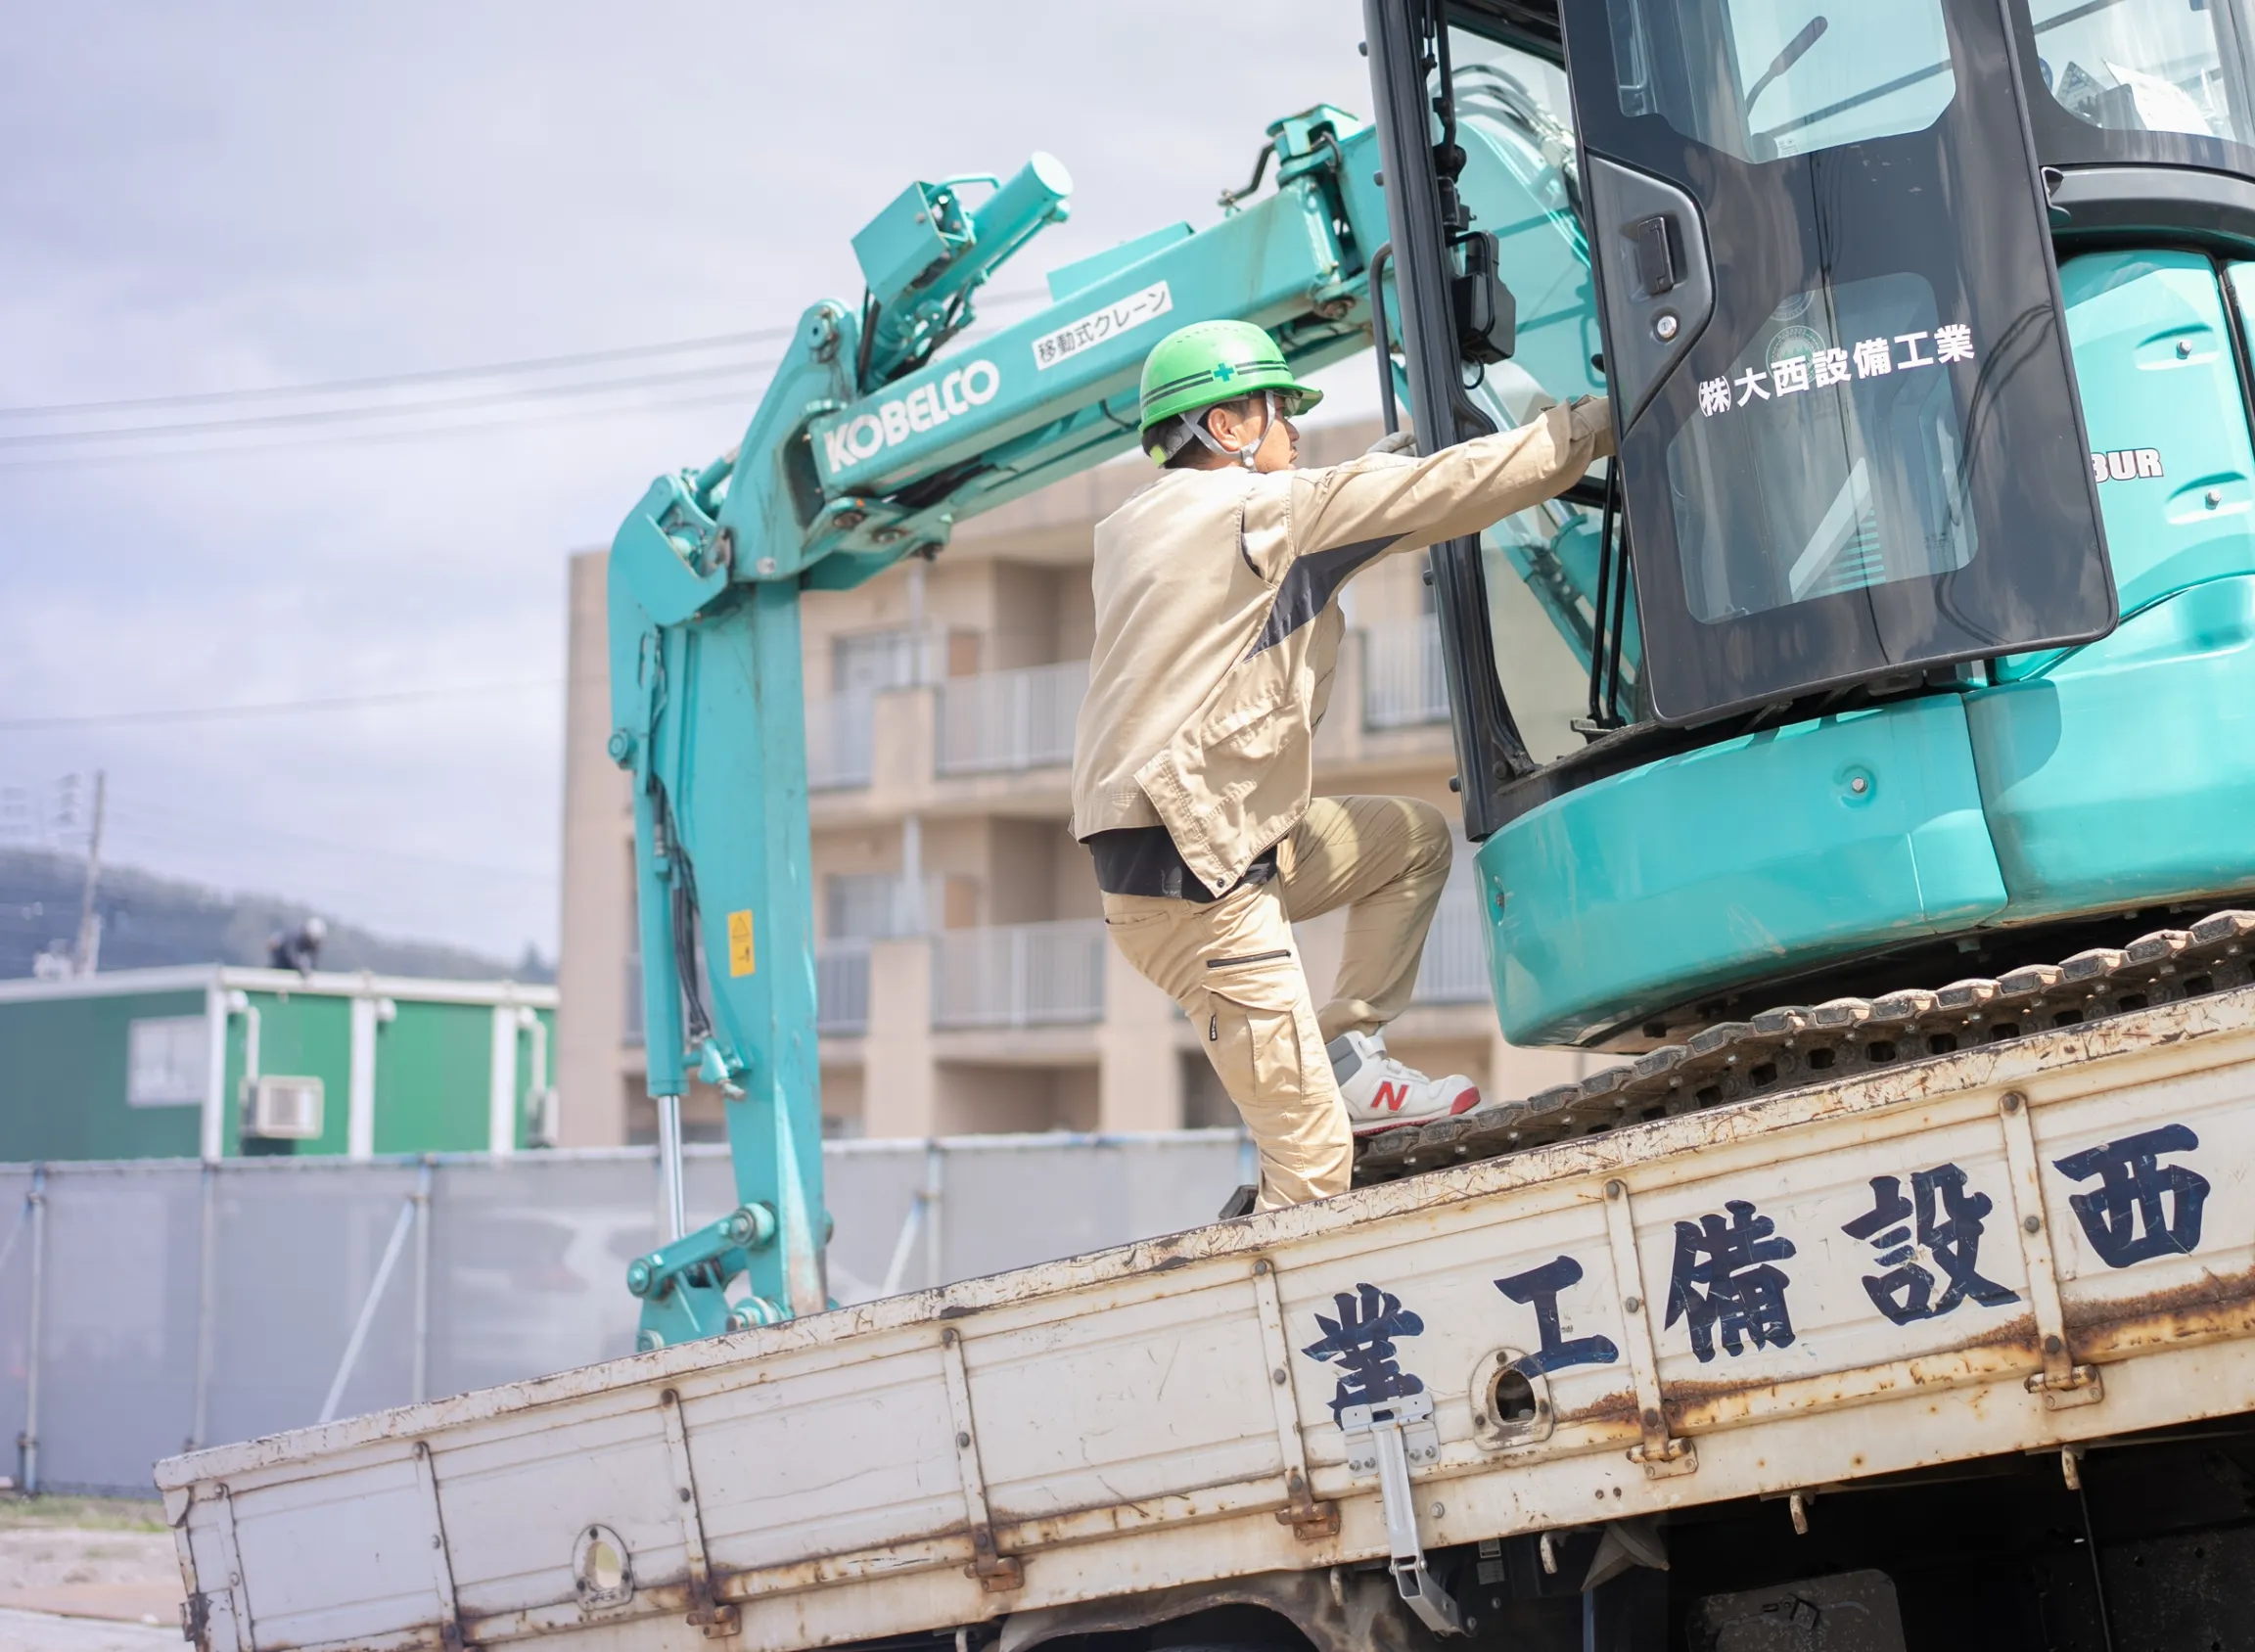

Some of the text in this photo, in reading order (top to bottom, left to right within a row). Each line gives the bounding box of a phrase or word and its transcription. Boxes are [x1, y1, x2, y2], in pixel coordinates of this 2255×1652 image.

[1037, 291, 1166, 363] 移動式クレーン
[823, 359, 1000, 474] KOBELCO
[1370, 1080, 1409, 1112] N
